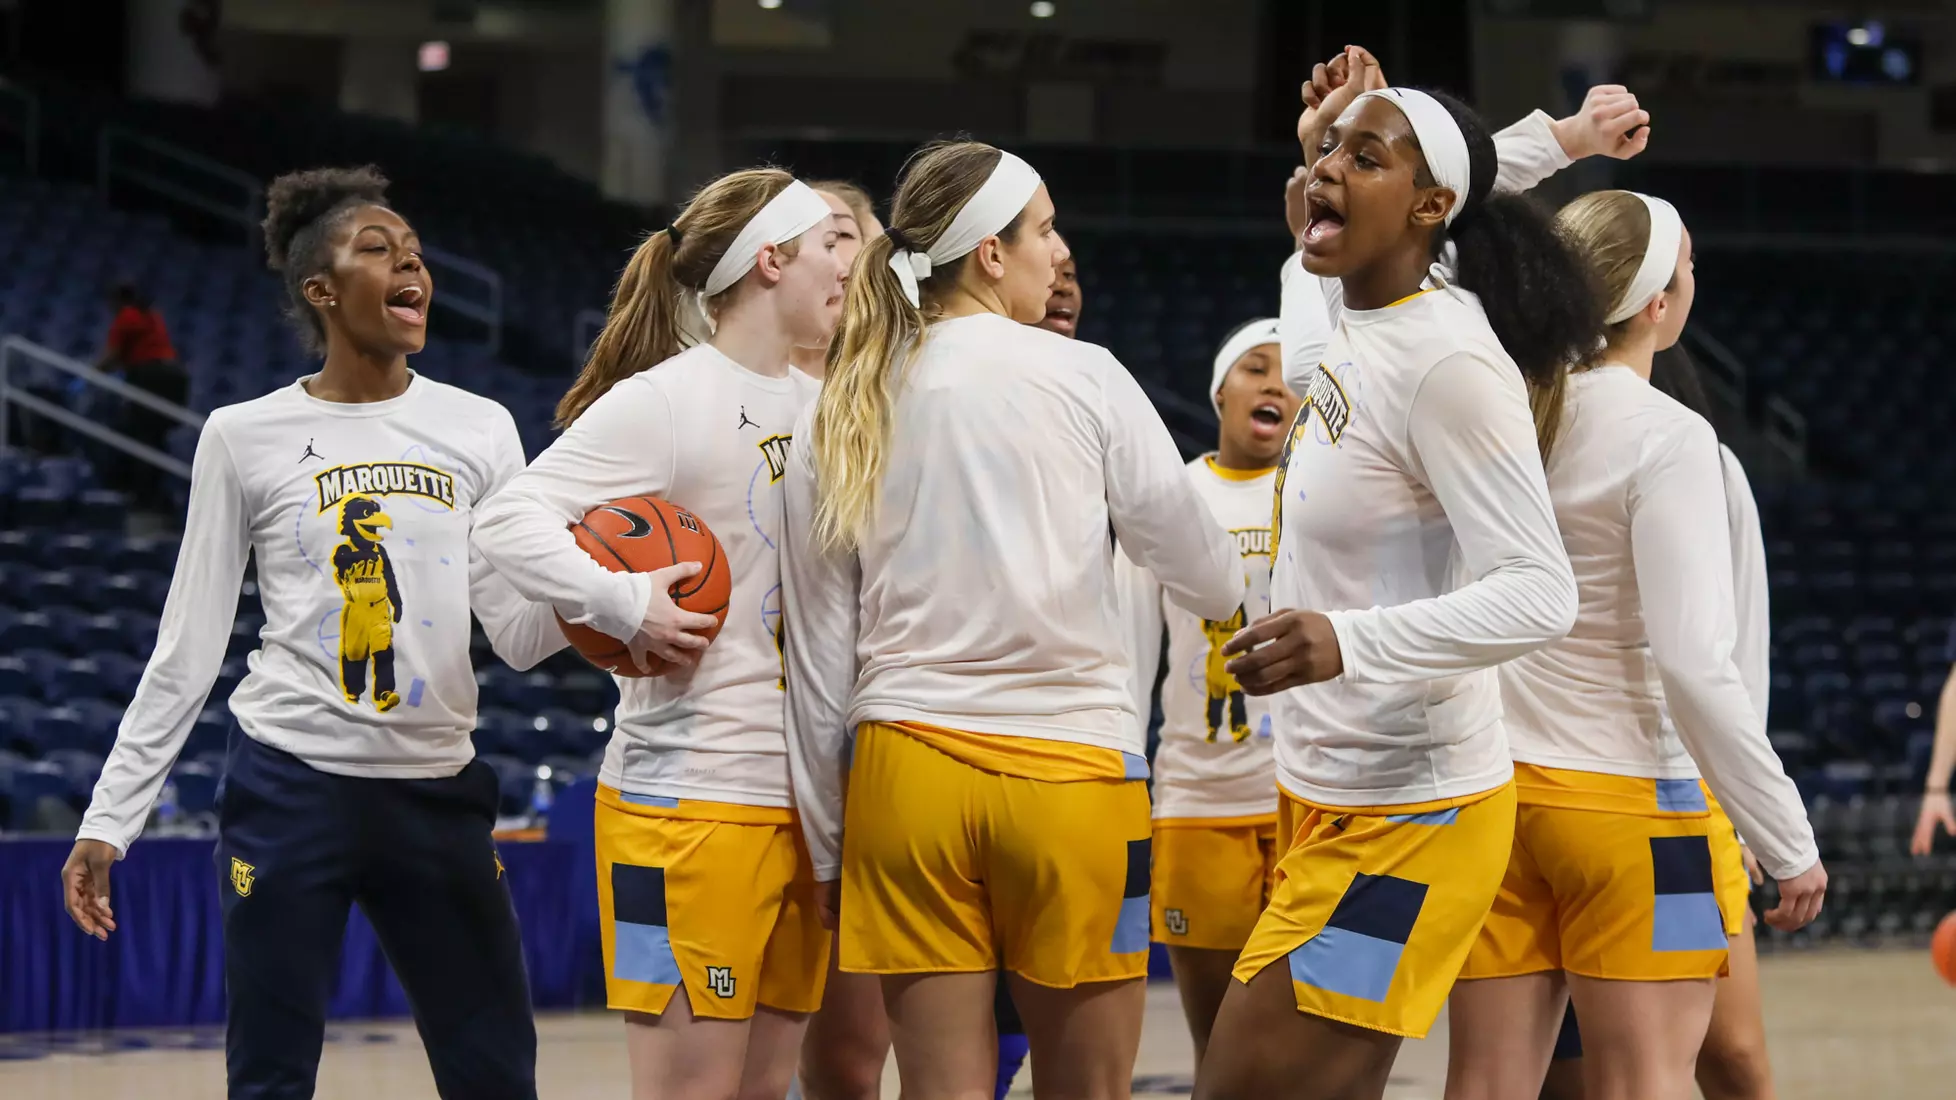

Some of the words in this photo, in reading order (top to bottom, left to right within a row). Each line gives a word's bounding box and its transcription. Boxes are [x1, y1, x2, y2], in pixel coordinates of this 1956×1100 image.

[318, 464, 453, 508] MARQUETTE
[231, 857, 254, 897] MU
[1165, 908, 1188, 936] MU
[706, 966, 736, 998] MU
